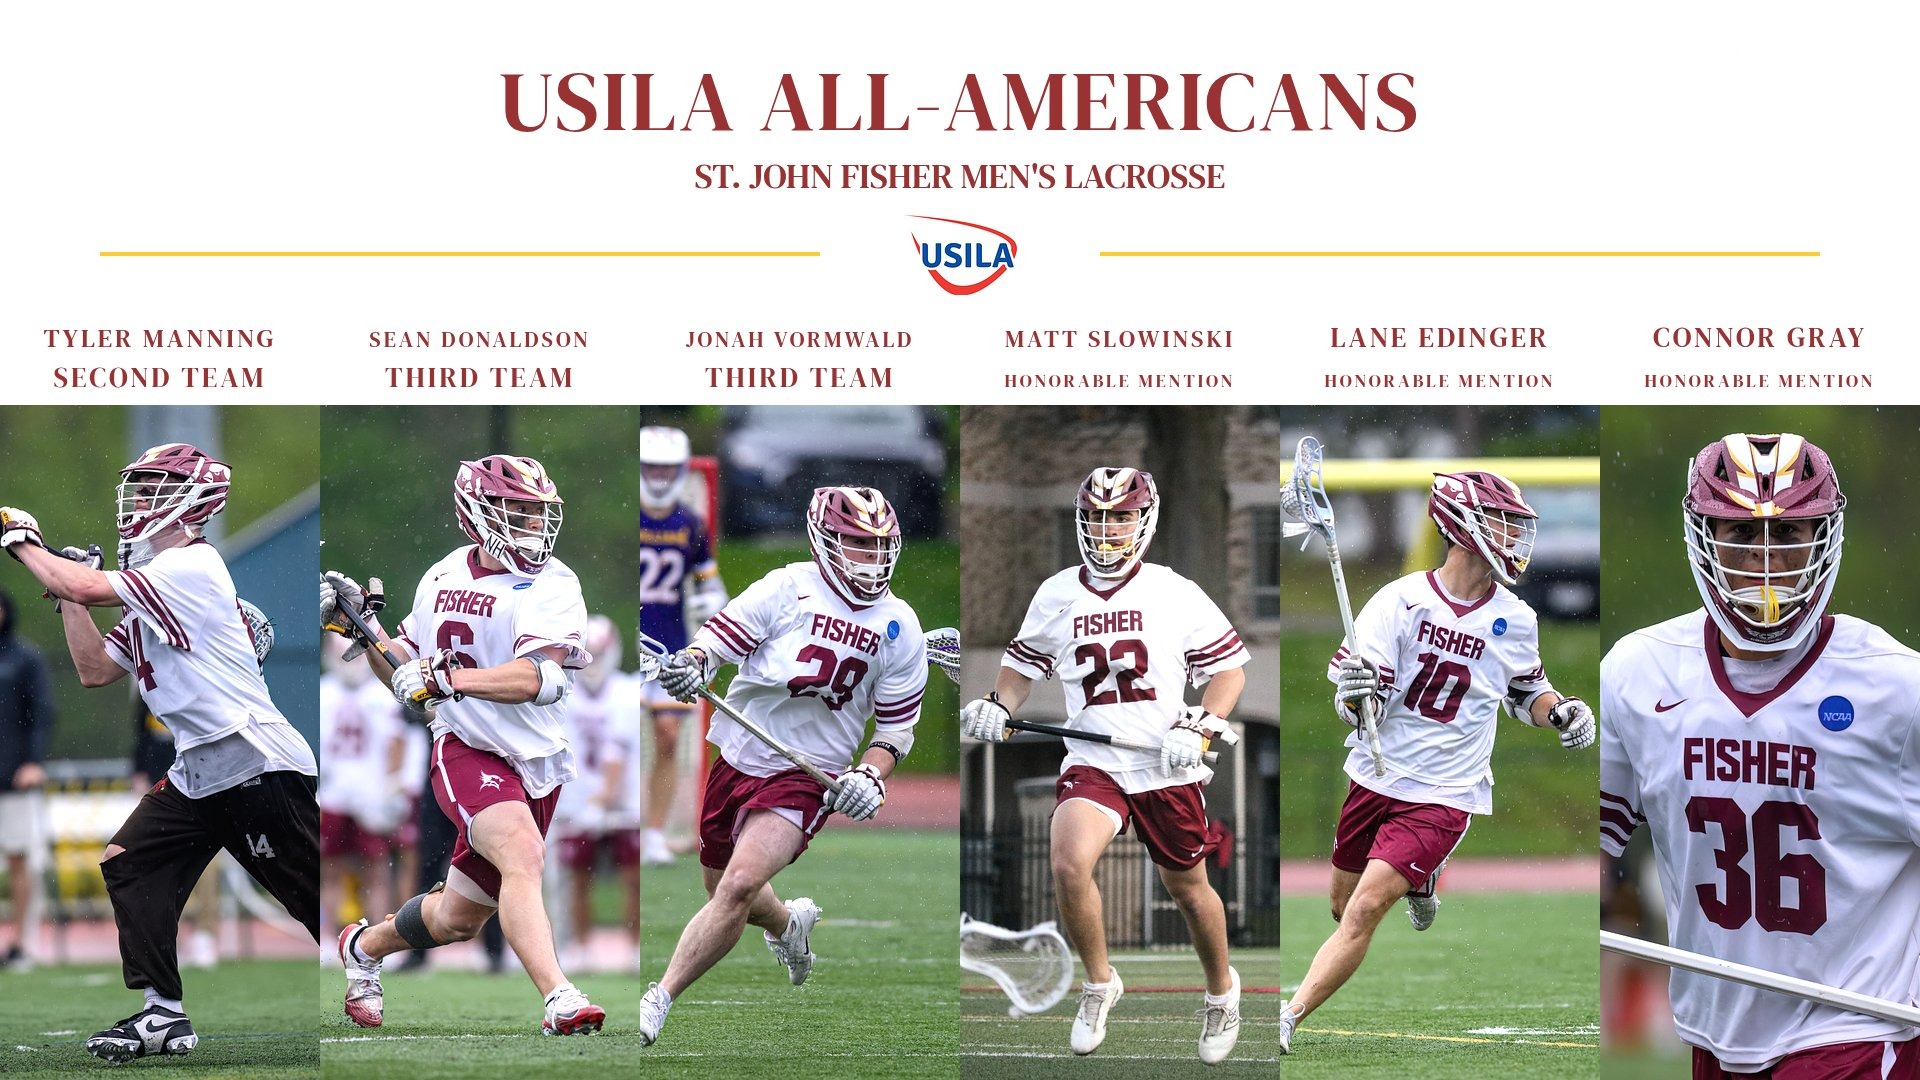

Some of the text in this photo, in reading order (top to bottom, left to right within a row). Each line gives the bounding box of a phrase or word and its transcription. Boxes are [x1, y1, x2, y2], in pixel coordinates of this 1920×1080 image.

[484, 534, 505, 558] NH
[434, 589, 497, 618] FISHER
[1073, 610, 1143, 639] FISHER
[811, 613, 881, 657] FISHER
[1417, 620, 1486, 660] FISHER
[787, 643, 869, 711] 29
[1074, 639, 1157, 708] 22
[1403, 652, 1472, 724] 10
[1823, 712, 1851, 722] NCAA
[1683, 737, 1817, 791] FISHER
[245, 833, 276, 859] 14
[1684, 795, 1828, 936] 36
